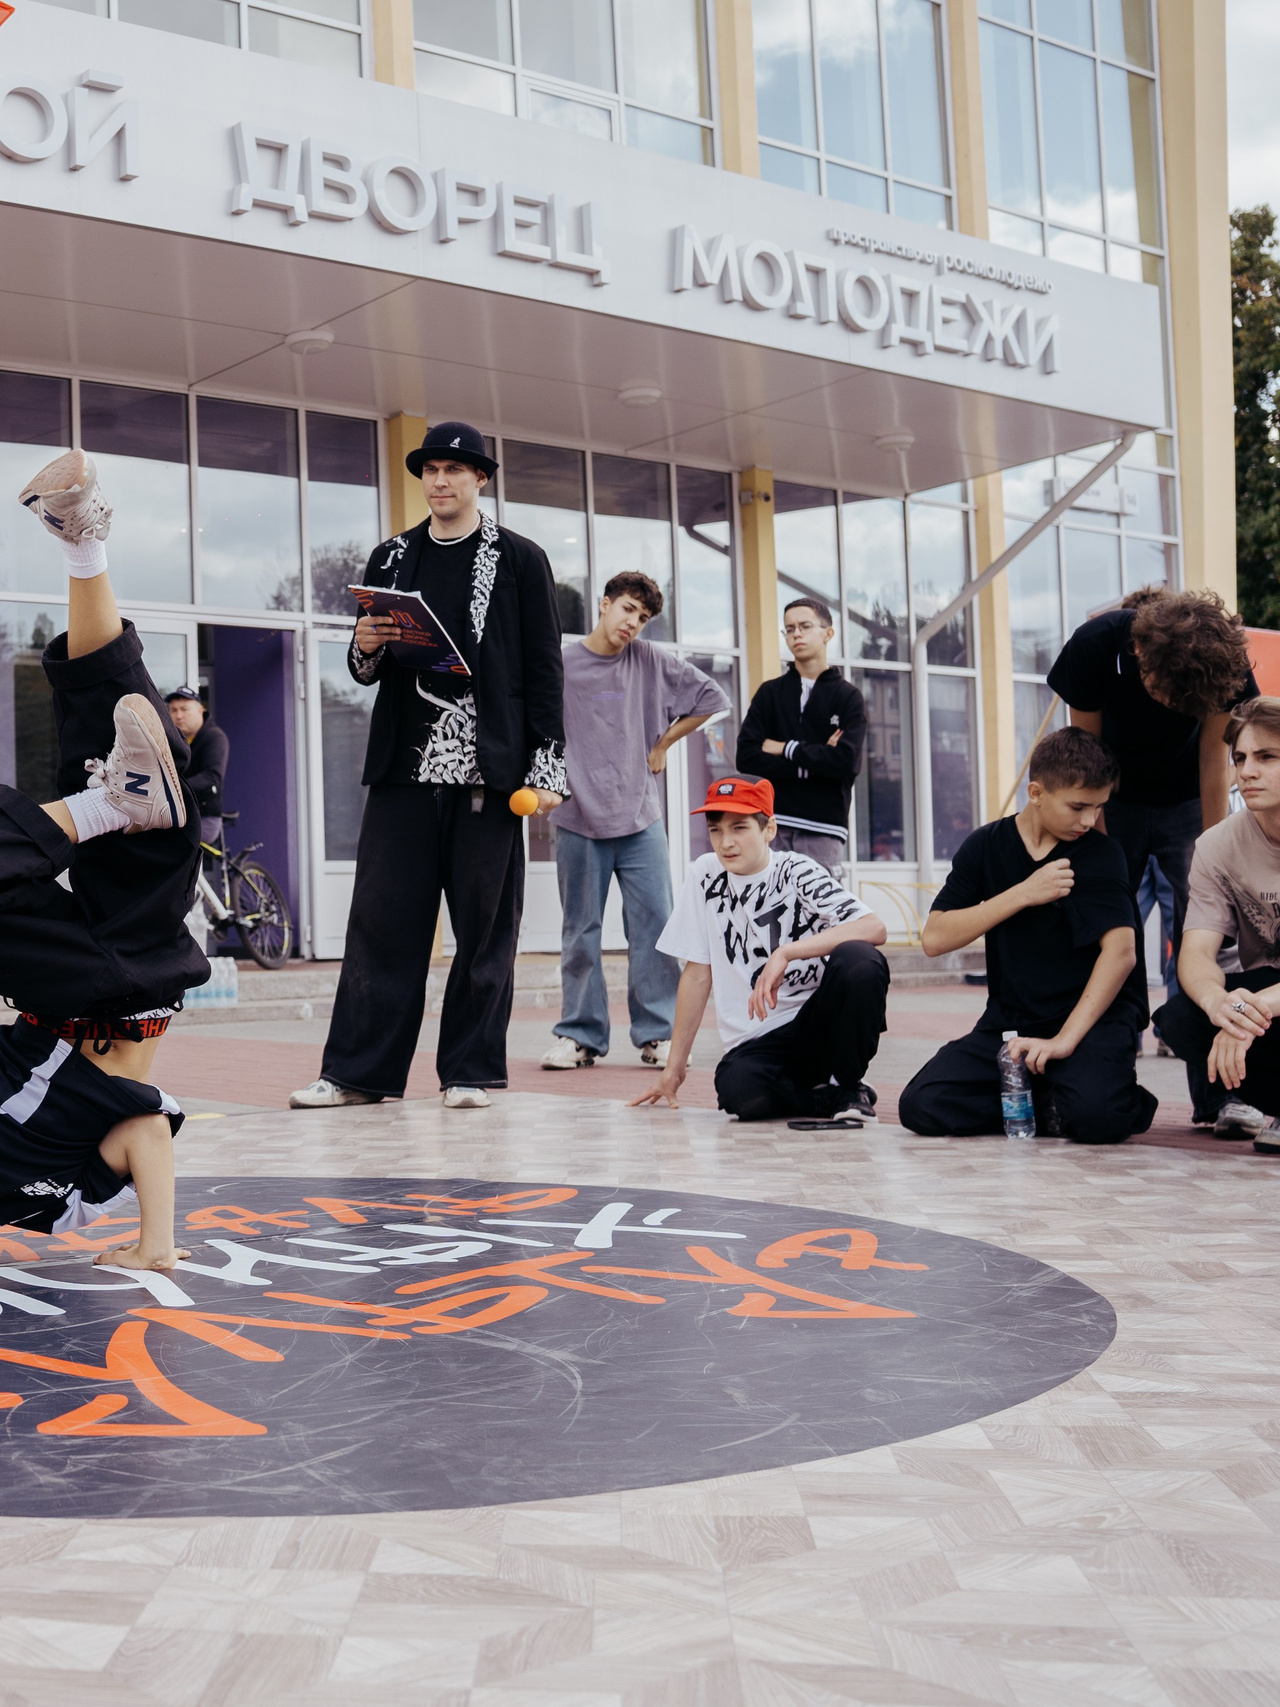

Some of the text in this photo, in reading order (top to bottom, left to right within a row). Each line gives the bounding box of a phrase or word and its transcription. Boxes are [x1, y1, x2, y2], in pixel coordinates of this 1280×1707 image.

[231, 121, 611, 286] ДВОРЕЦ
[673, 223, 1061, 374] МОЛОДЕЖИ
[124, 771, 151, 797] N
